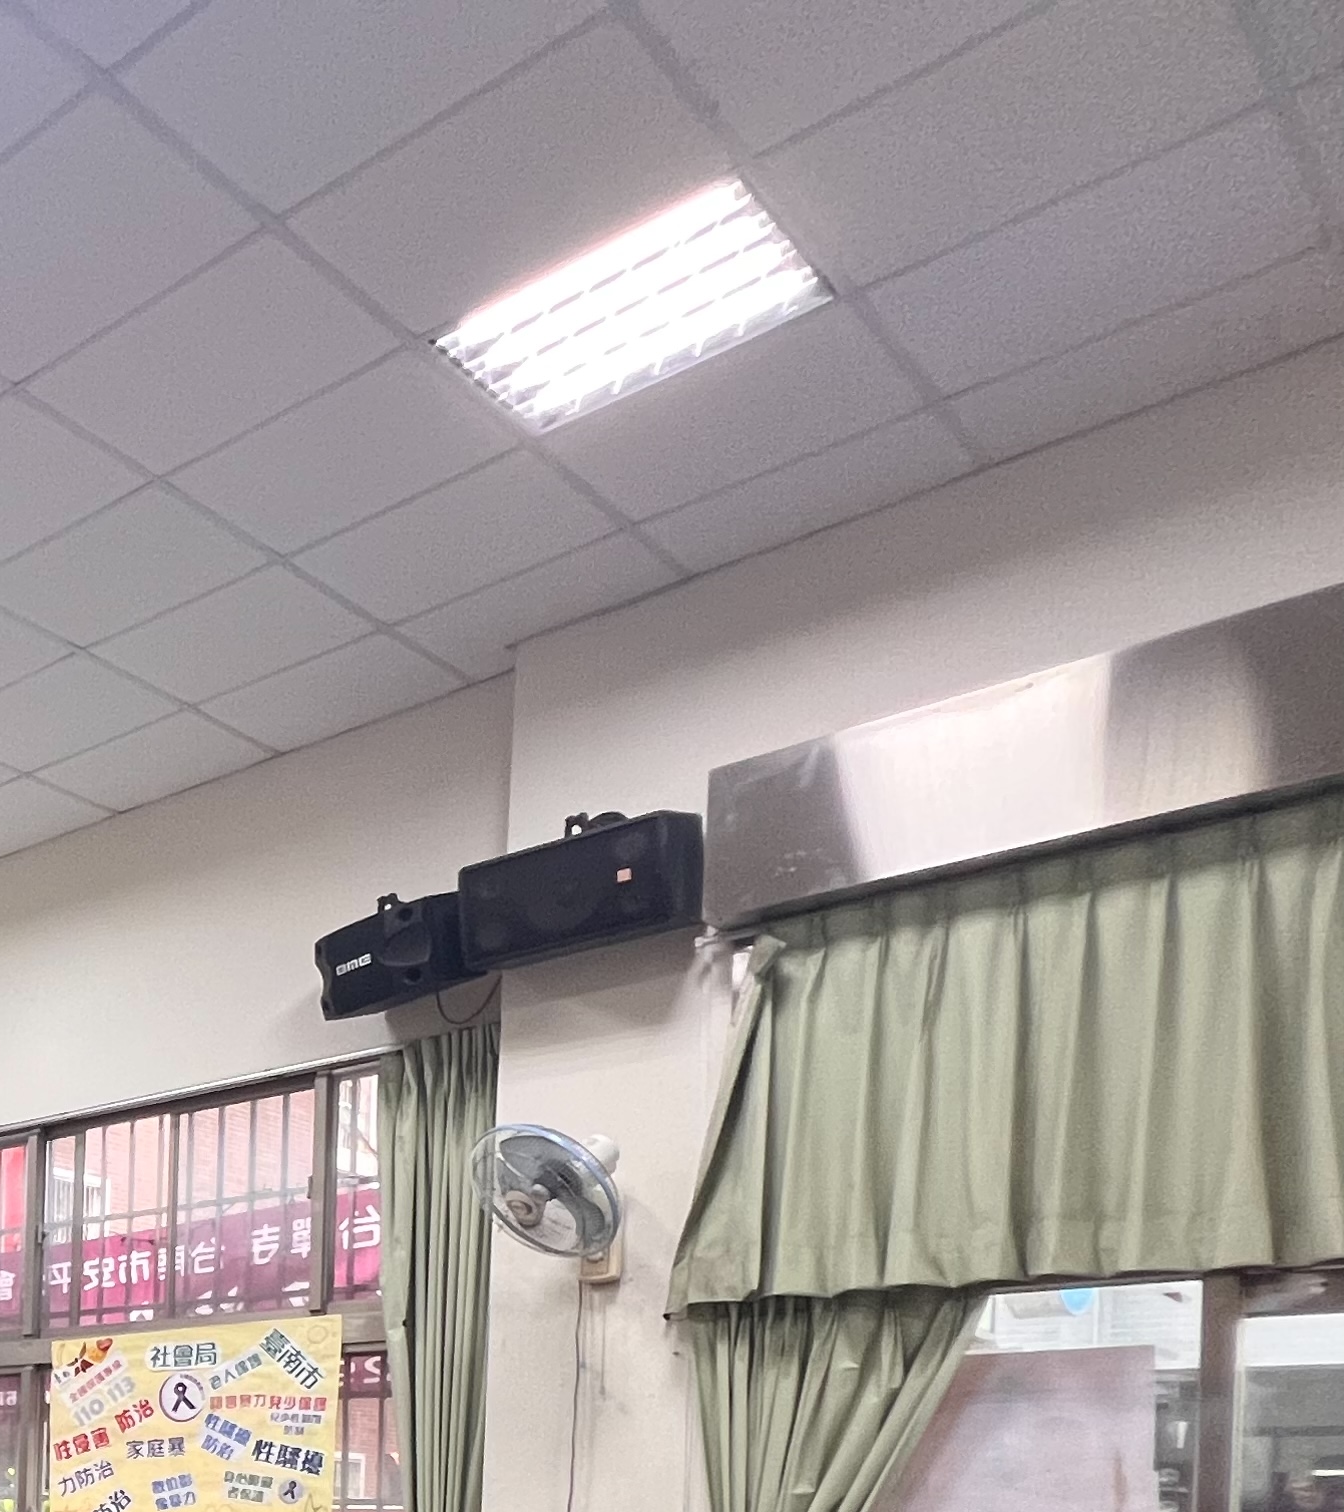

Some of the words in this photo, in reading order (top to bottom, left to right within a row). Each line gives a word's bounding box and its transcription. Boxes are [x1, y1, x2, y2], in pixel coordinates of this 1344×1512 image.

[150, 1342, 217, 1367] 社會局
[260, 1329, 325, 1390] 臺南市
[115, 1399, 154, 1433] 防治
